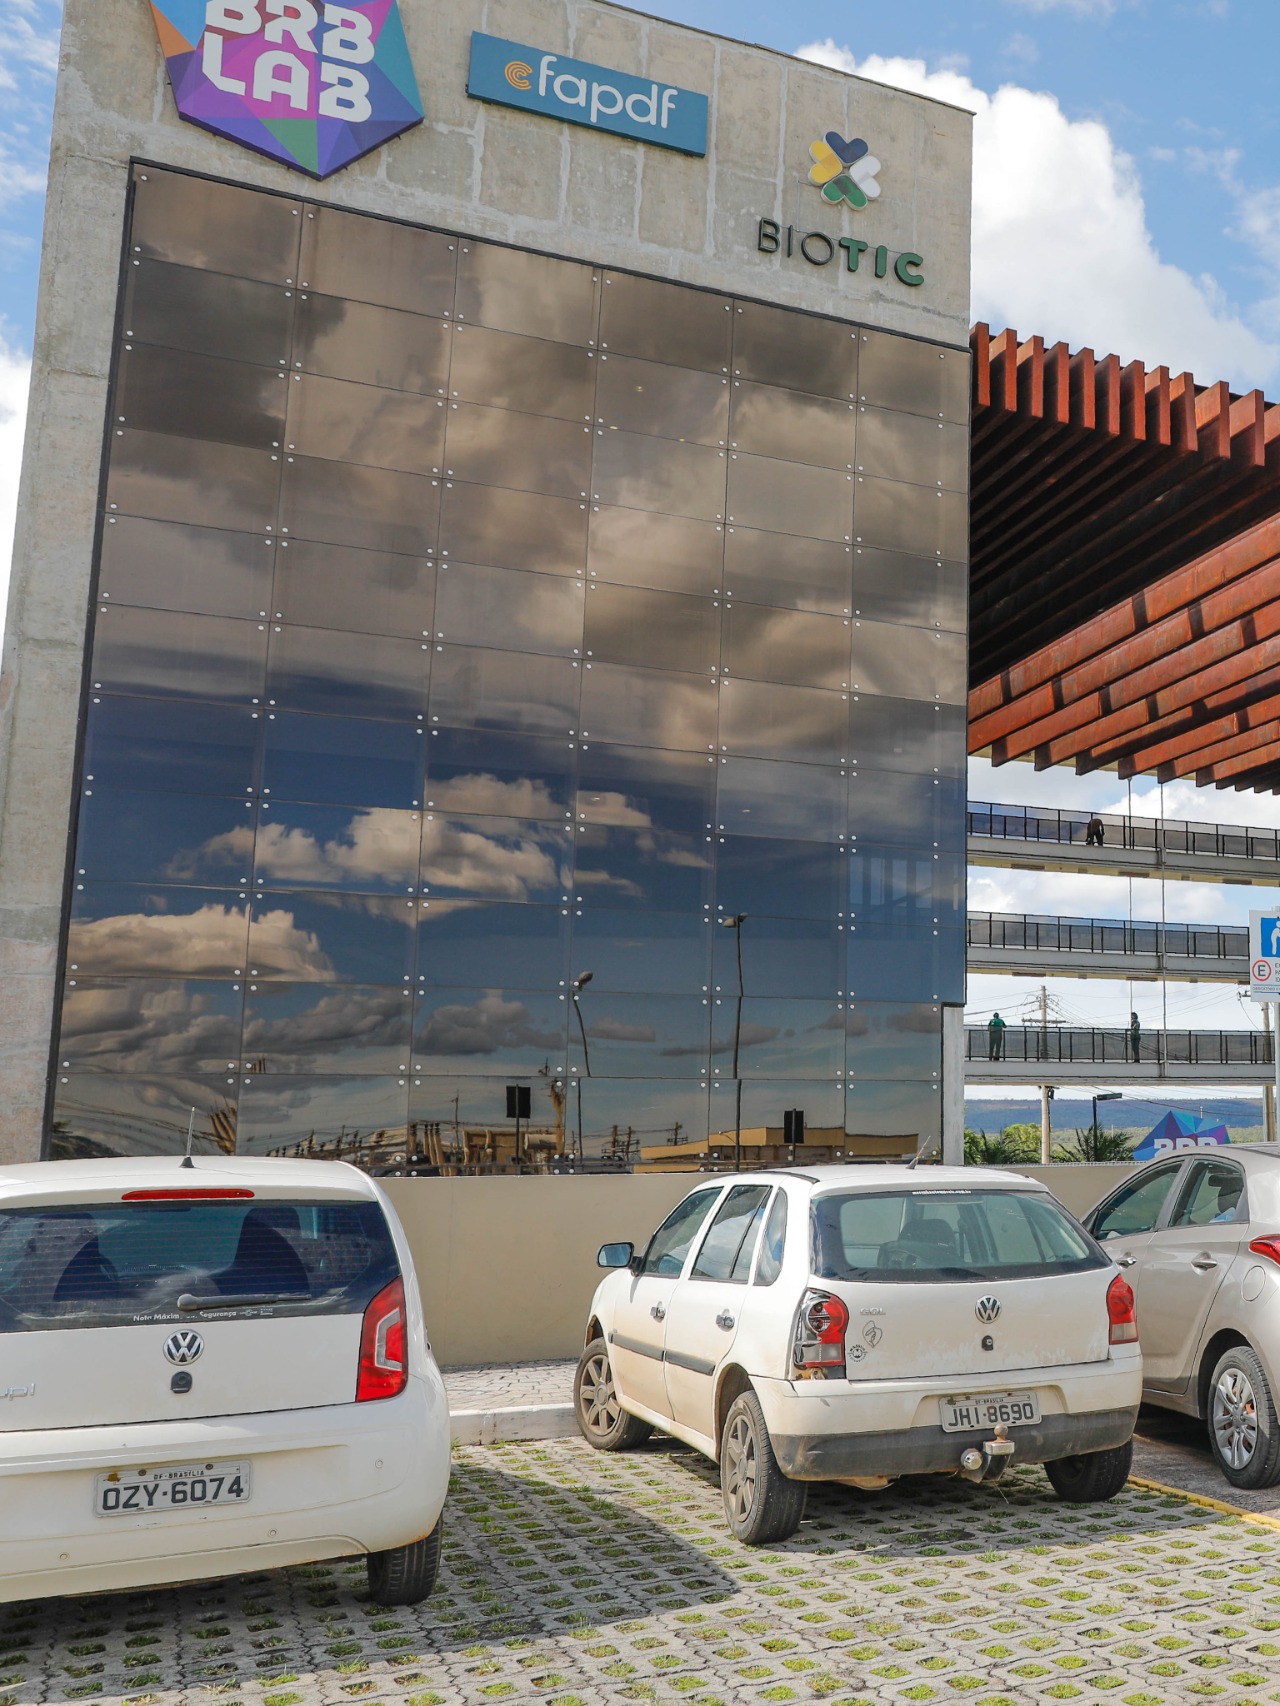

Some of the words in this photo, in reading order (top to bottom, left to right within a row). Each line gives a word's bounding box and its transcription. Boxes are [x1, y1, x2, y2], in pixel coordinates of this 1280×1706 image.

[202, 31, 372, 122] LAB
[538, 55, 679, 128] fapdf
[758, 217, 924, 286] BIOTIC
[1258, 965, 1266, 976] E
